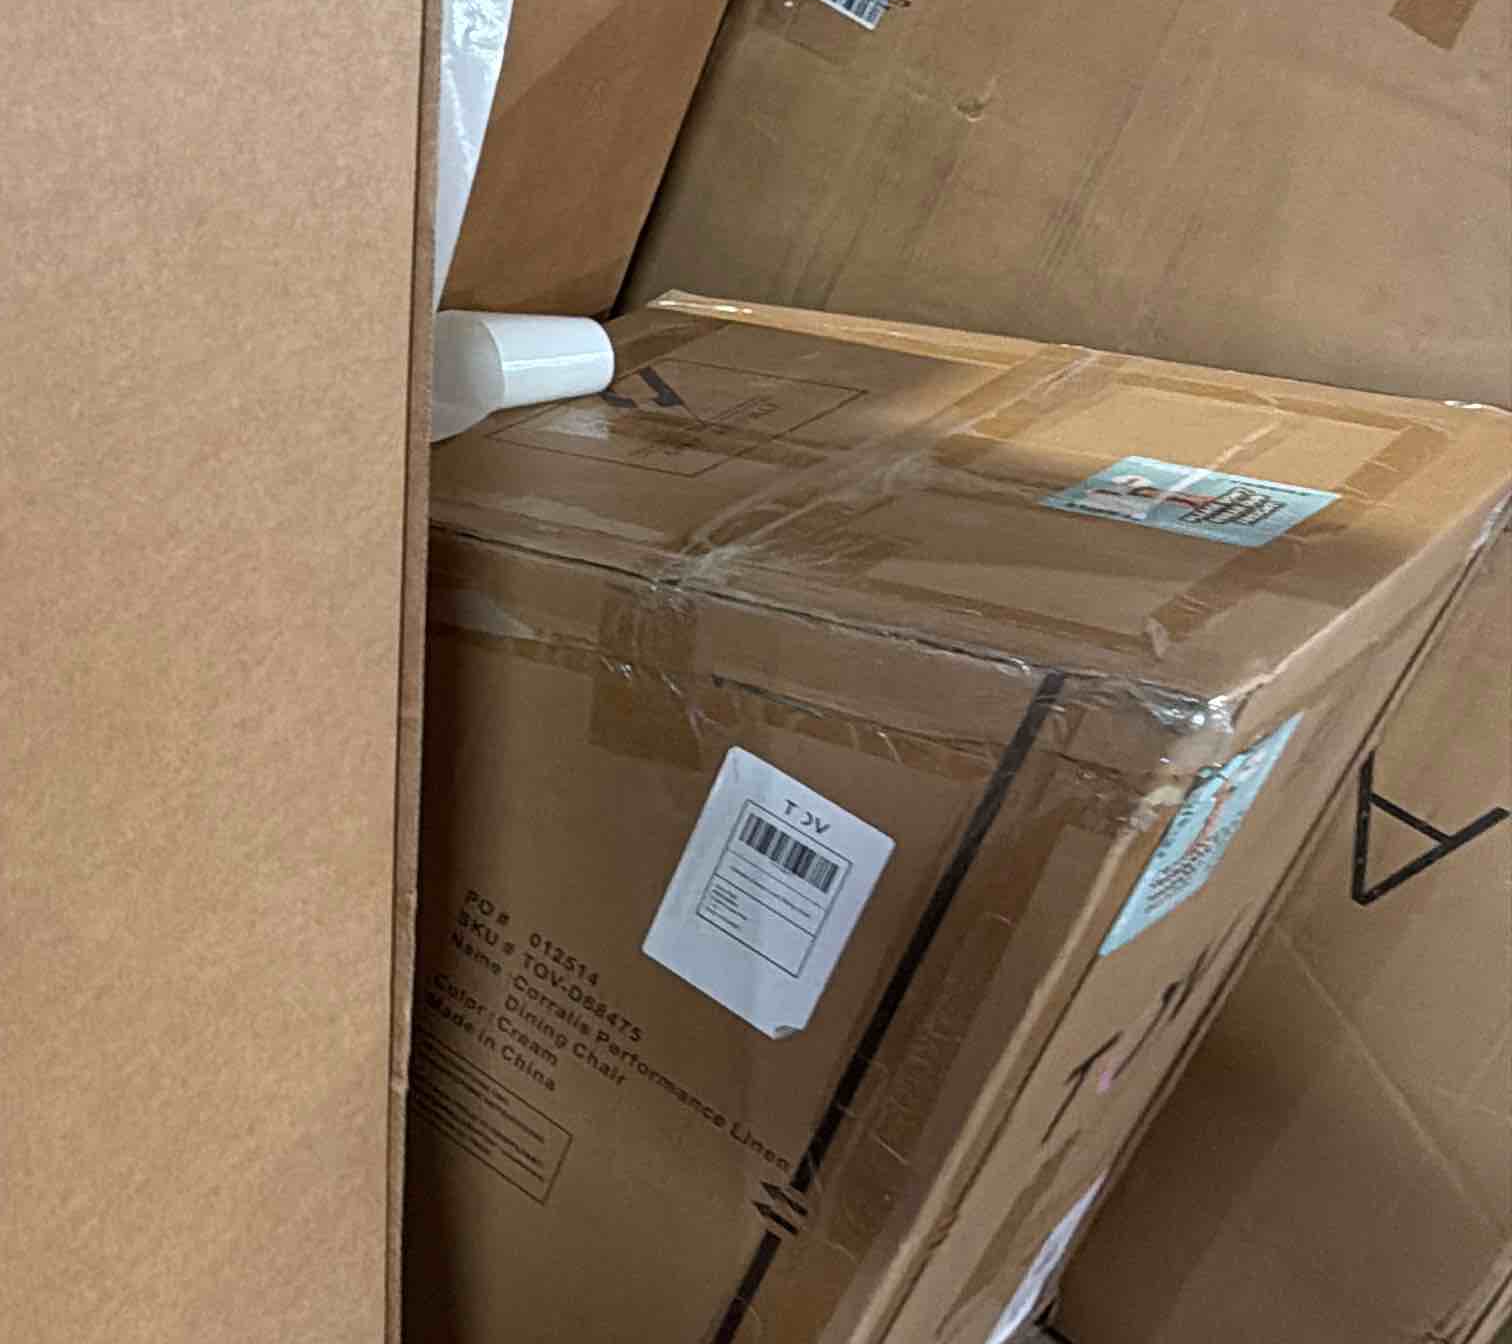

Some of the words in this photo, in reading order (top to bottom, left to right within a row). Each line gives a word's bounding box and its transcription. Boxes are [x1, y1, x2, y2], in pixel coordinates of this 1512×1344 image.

[497, 1015, 559, 1067] Cream
[501, 1046, 556, 1092] China
[504, 994, 568, 1050] Dining
[572, 1042, 626, 1086] Chair
[596, 1030, 727, 1129] Performance
